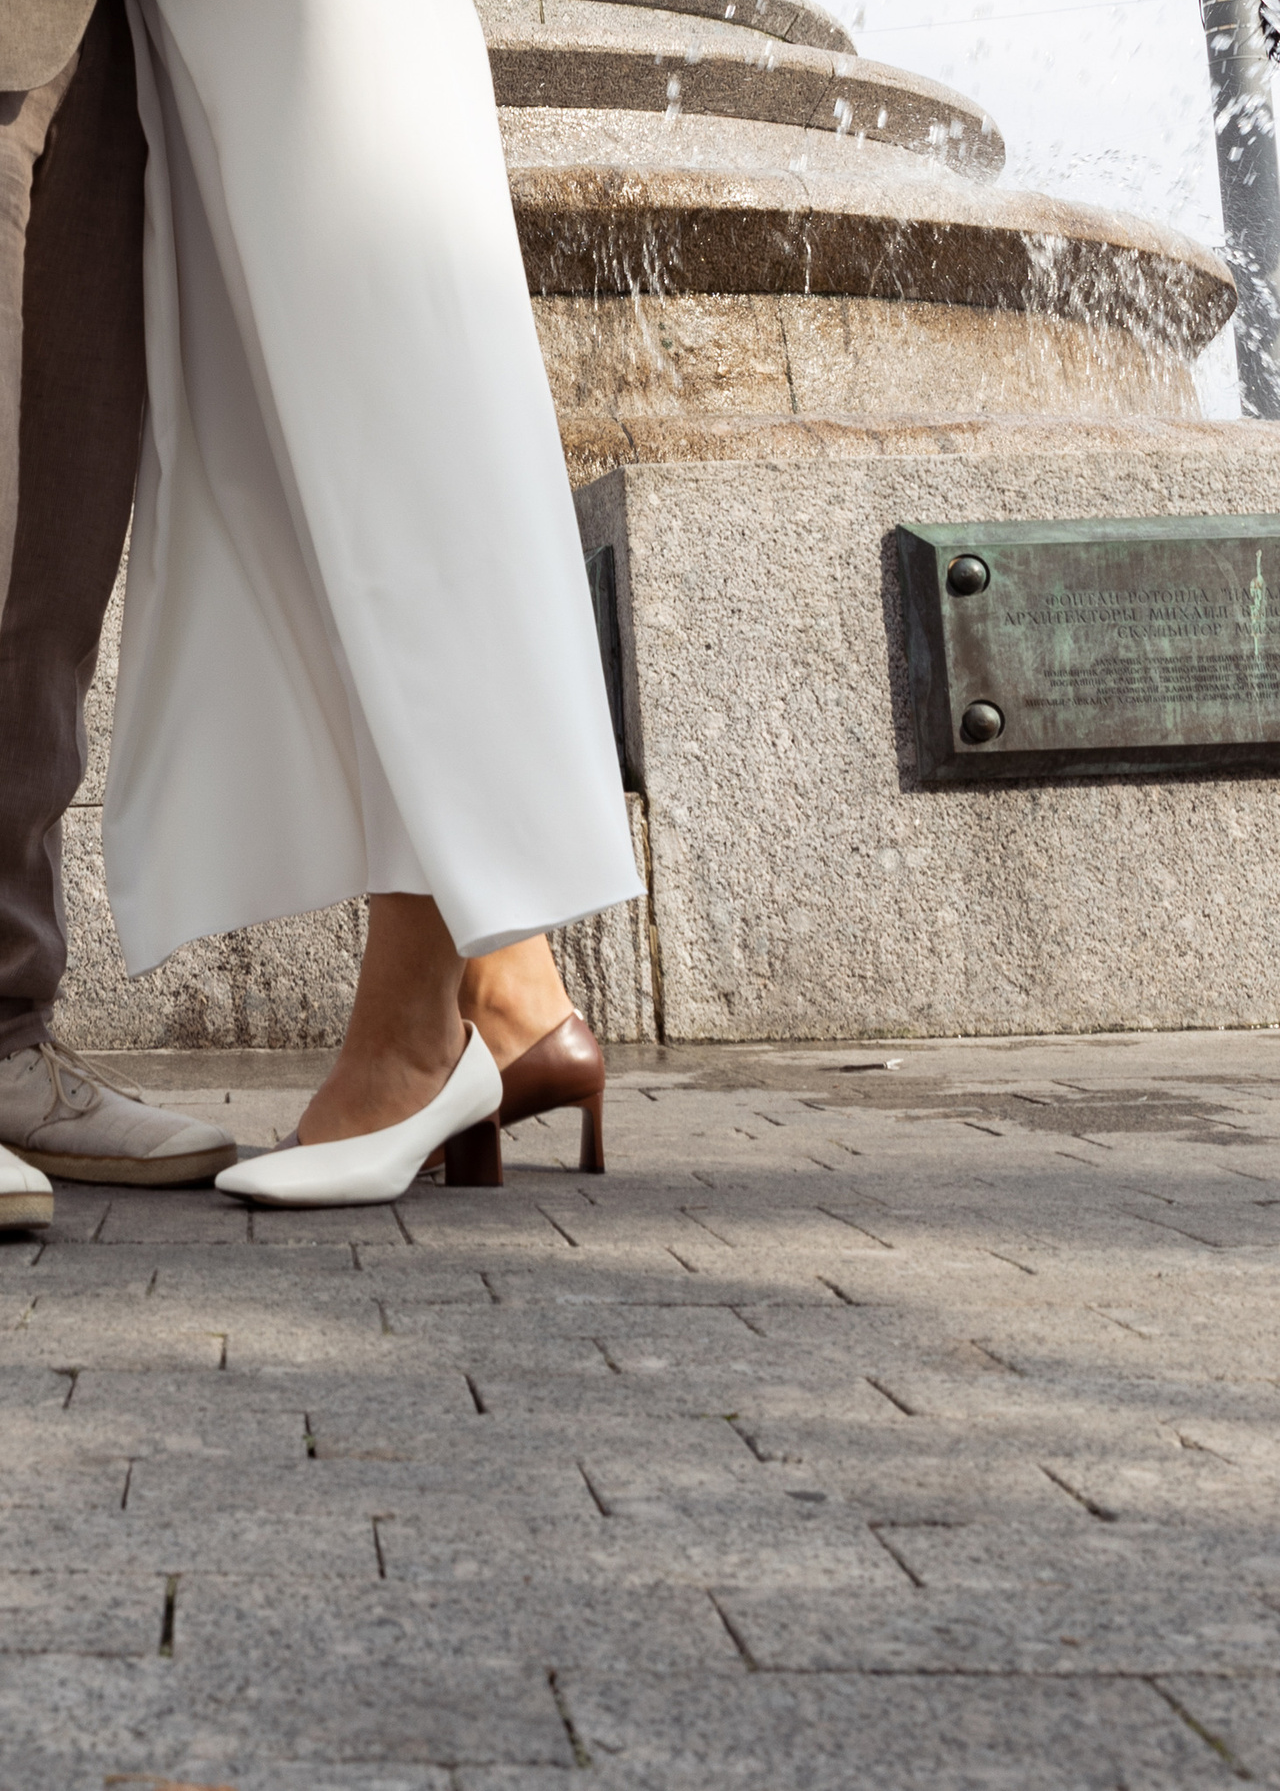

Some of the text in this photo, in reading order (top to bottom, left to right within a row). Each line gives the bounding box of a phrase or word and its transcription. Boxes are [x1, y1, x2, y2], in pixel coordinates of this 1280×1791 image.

[1004, 609, 1136, 627] АРХИТЕКТОРЫ
[1148, 605, 1229, 622] МИХАИЛ
[1117, 621, 1222, 639] СКУЛЬПТОР
